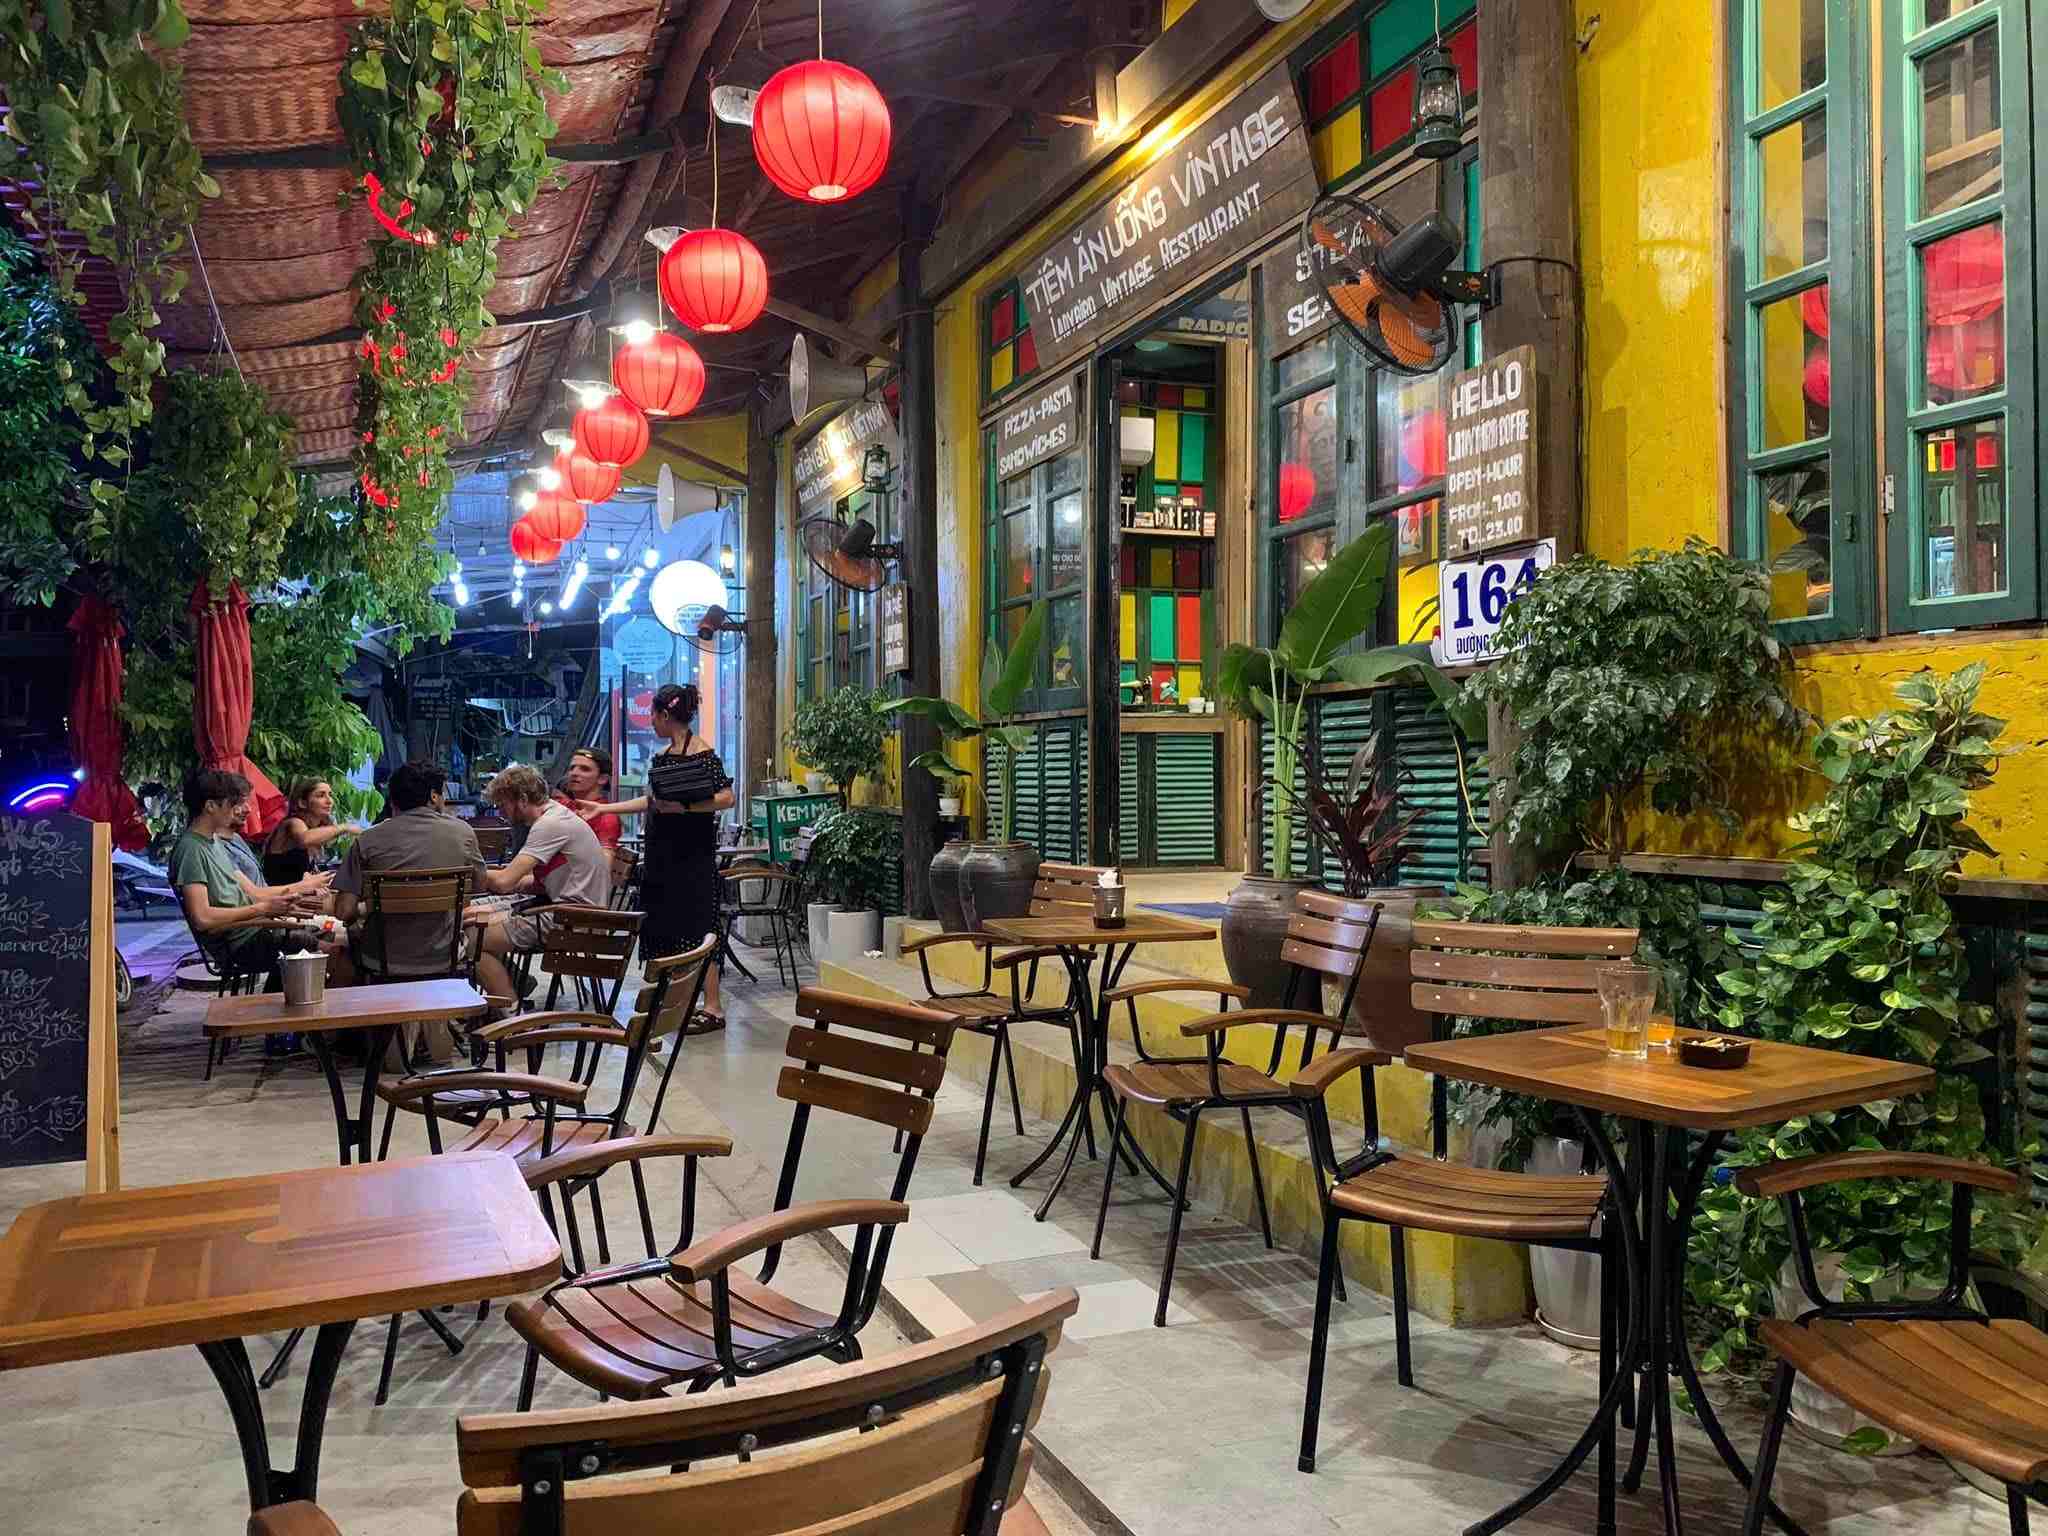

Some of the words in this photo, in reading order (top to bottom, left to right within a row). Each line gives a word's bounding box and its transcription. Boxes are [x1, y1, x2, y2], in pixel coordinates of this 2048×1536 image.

[1158, 182, 1260, 271] RESTAURANT
[1178, 317, 1249, 335] RADIO
[1451, 360, 1522, 420] HELLO
[776, 804, 808, 823] KEM
